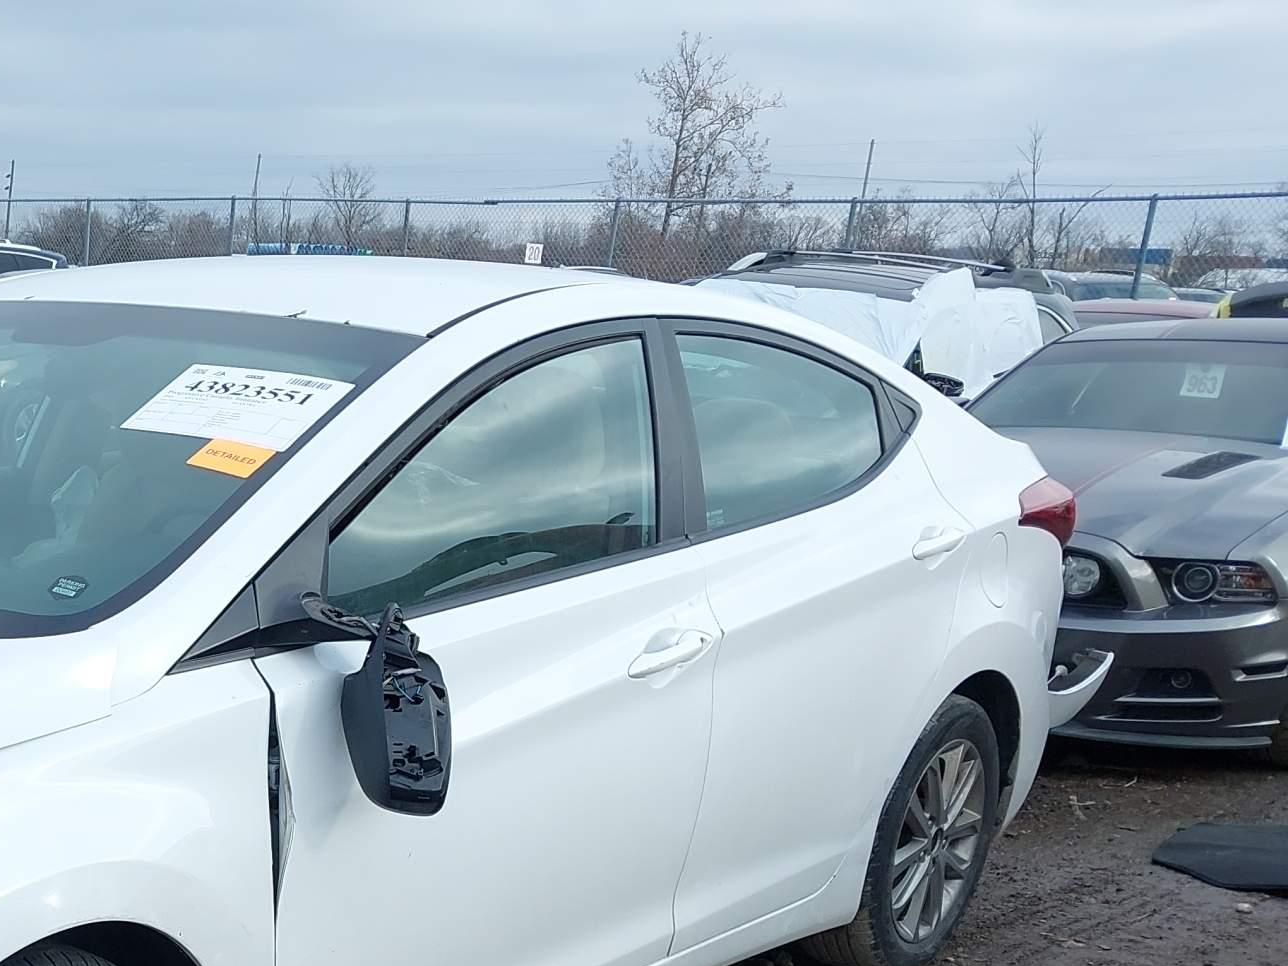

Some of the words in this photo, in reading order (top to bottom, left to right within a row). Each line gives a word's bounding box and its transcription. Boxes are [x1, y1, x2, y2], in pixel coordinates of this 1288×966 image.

[184, 379, 314, 406] 43823551
[1186, 374, 1218, 394] 963
[205, 448, 257, 465] DETAILED
